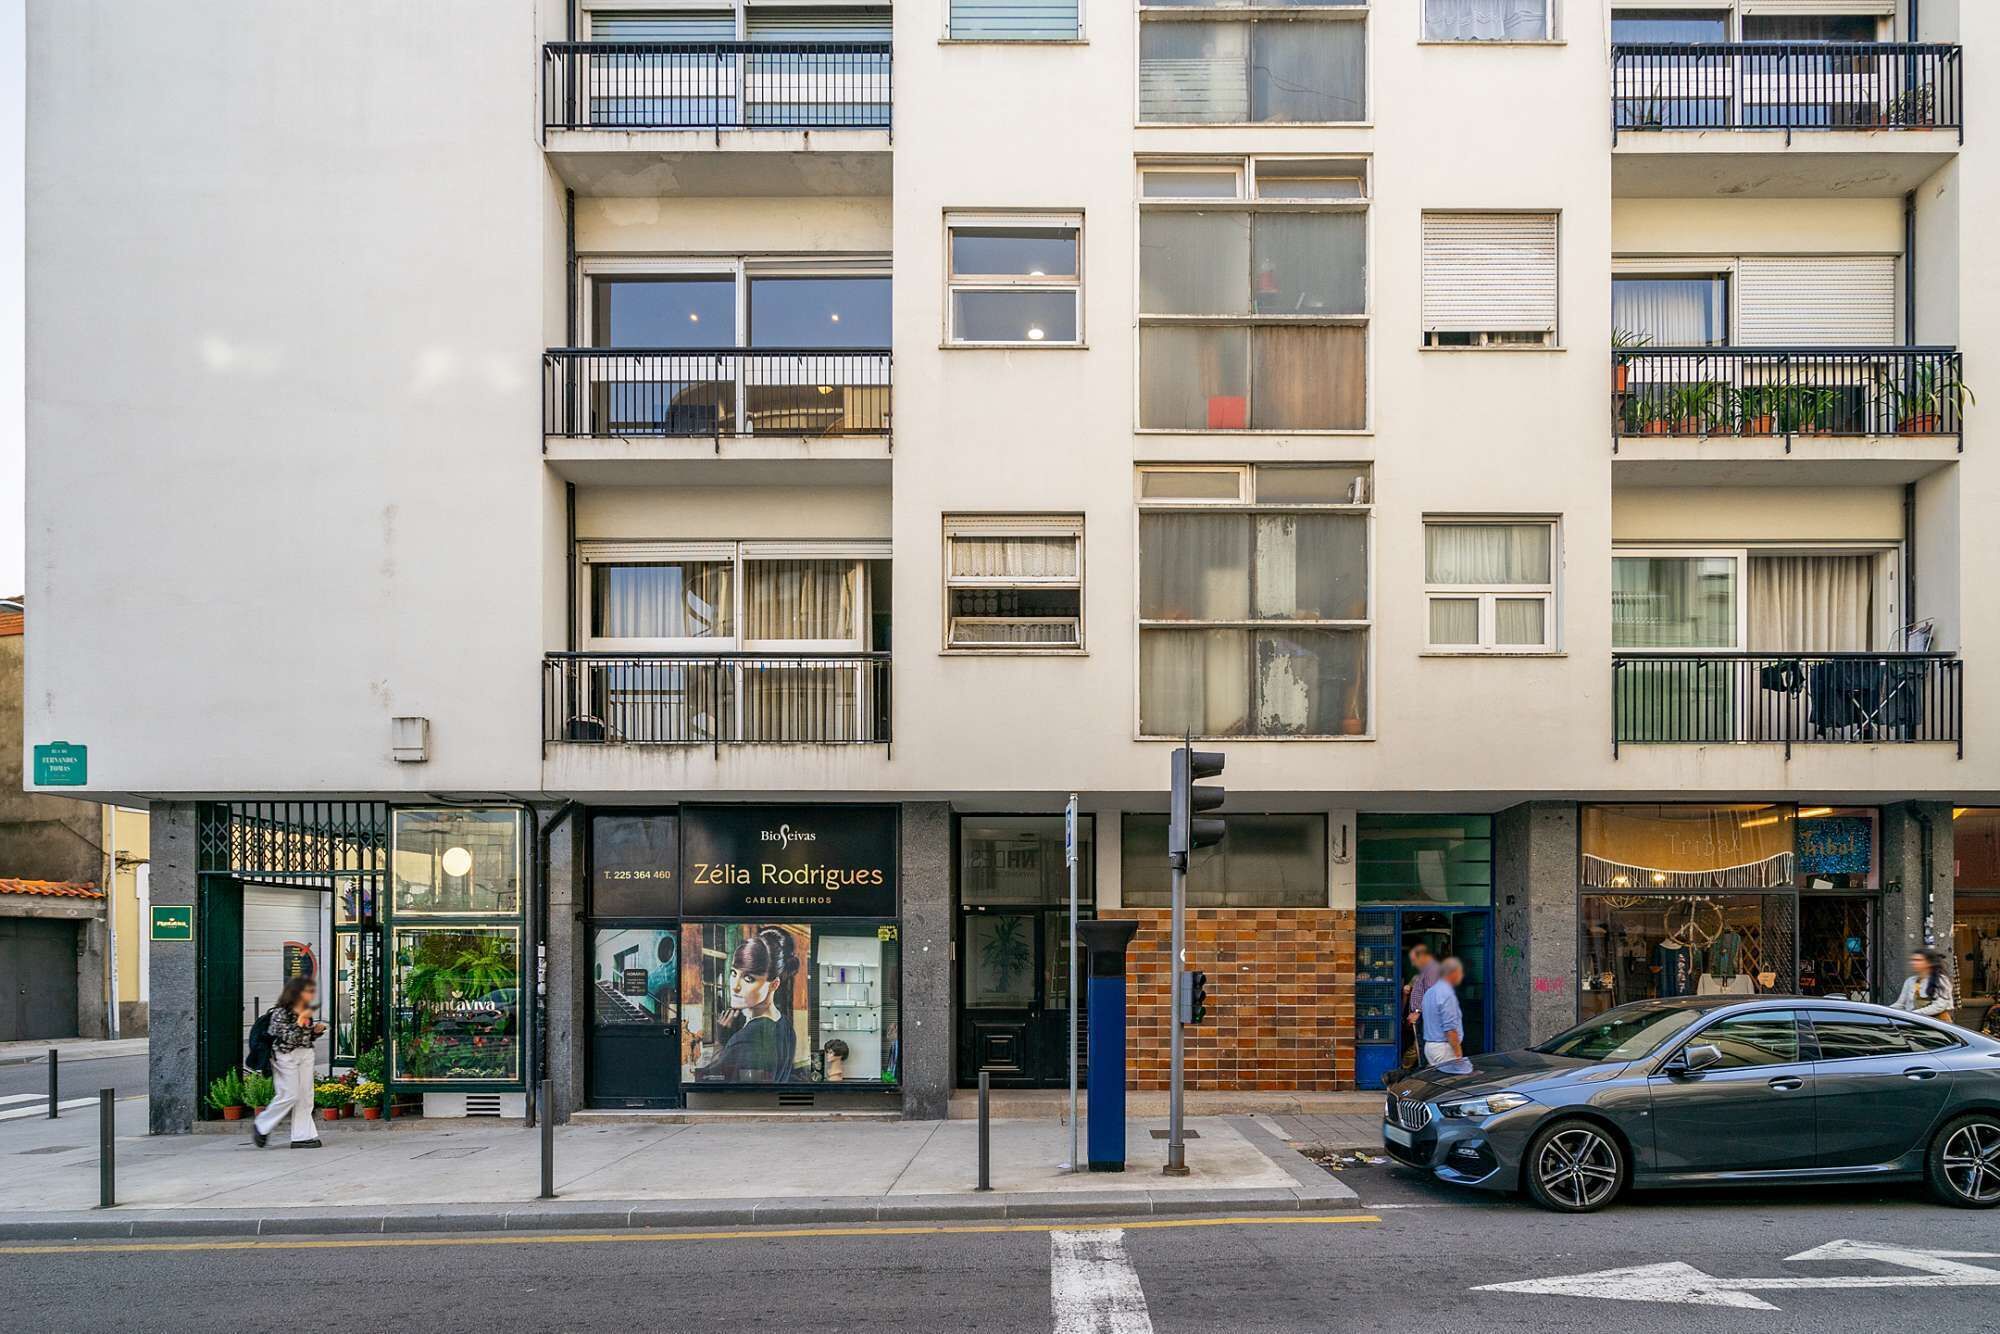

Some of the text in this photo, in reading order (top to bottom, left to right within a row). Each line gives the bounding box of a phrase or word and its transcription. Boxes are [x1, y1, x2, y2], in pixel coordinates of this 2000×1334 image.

[760, 823, 817, 850] BioSeivas
[603, 870, 671, 880] T. 225 364 460
[693, 863, 884, 890] Zélia Rodrigues
[745, 896, 832, 904] CABELEIREIROS
